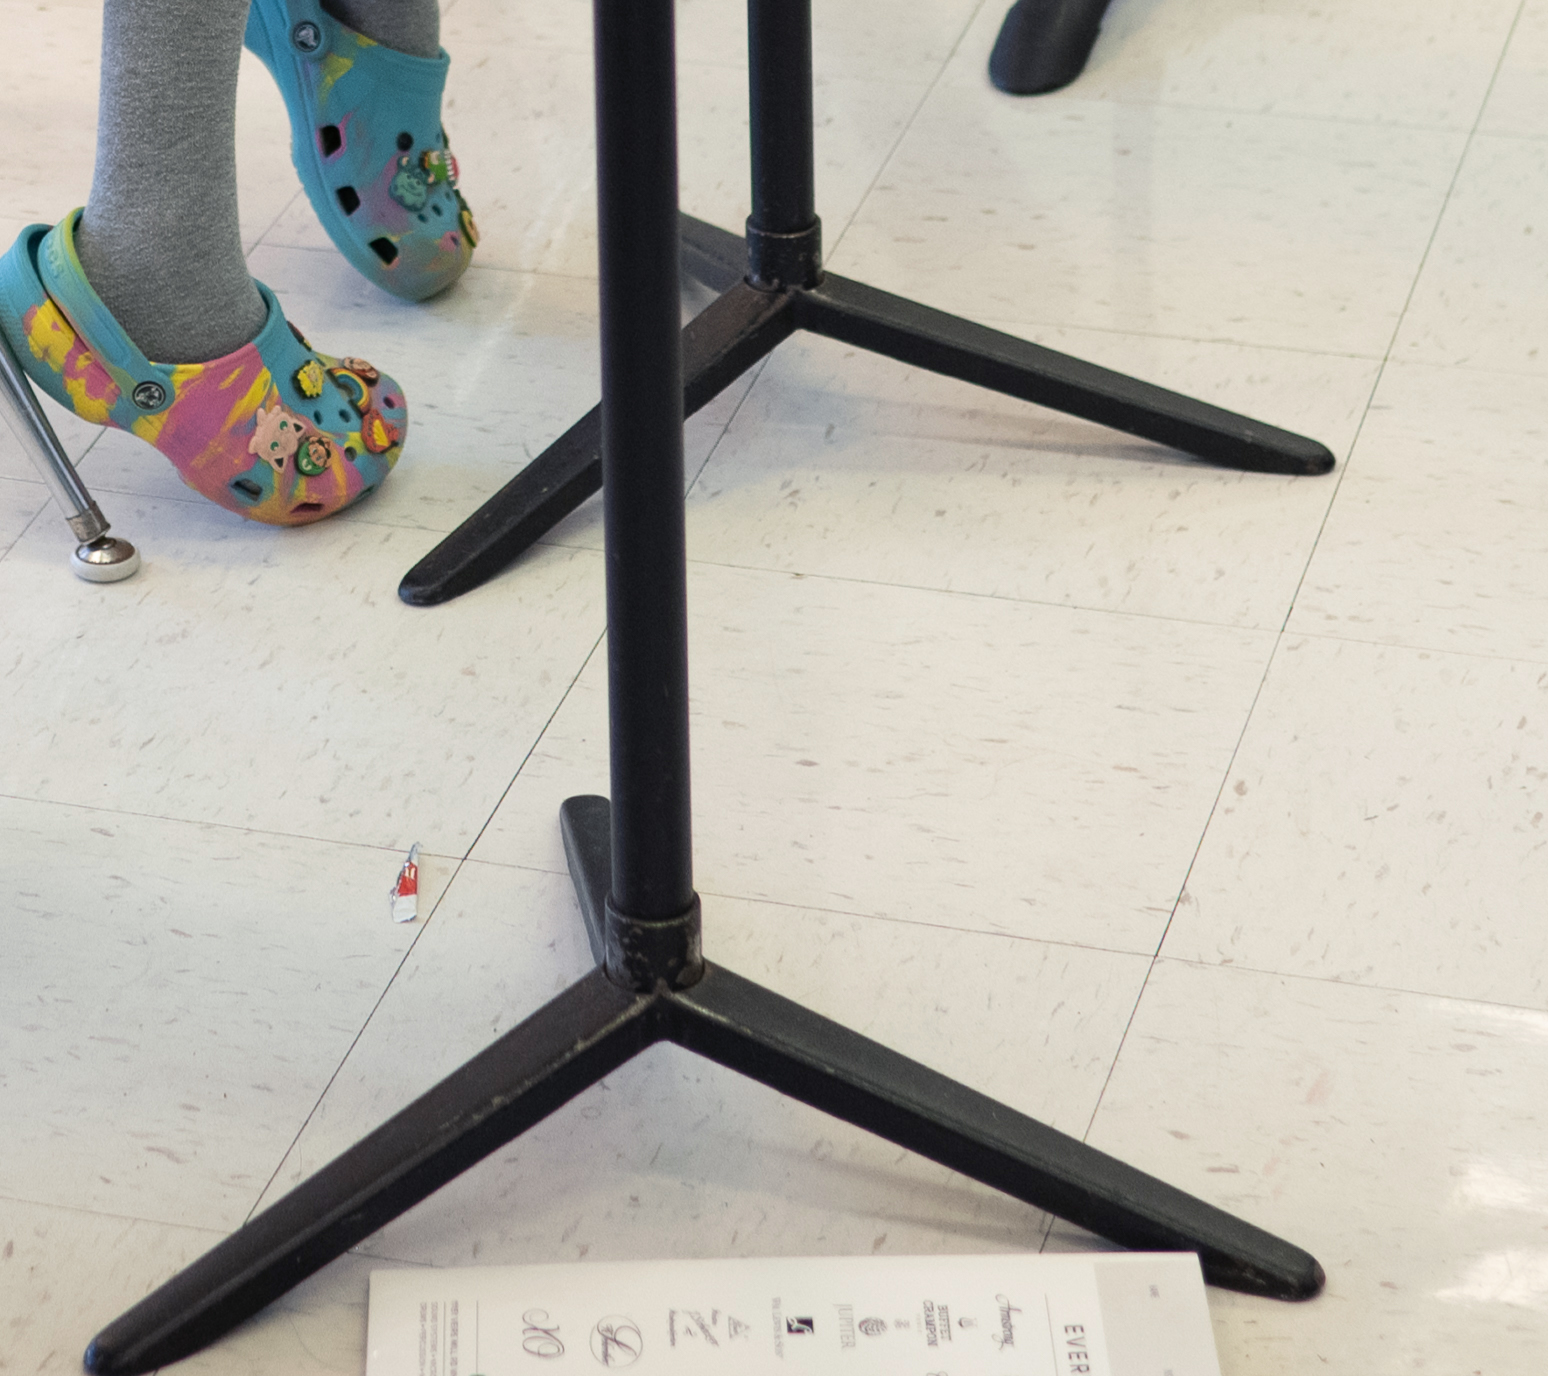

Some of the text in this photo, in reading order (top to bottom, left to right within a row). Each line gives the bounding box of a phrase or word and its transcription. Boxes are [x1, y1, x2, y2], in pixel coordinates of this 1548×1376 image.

[833, 1303, 856, 1349] JUPITER
[923, 1299, 938, 1347] CRAMPON
[937, 1304, 951, 1341] BUFFET
[991, 1293, 1023, 1351] Armstrong
[1064, 1324, 1090, 1375] EVER
